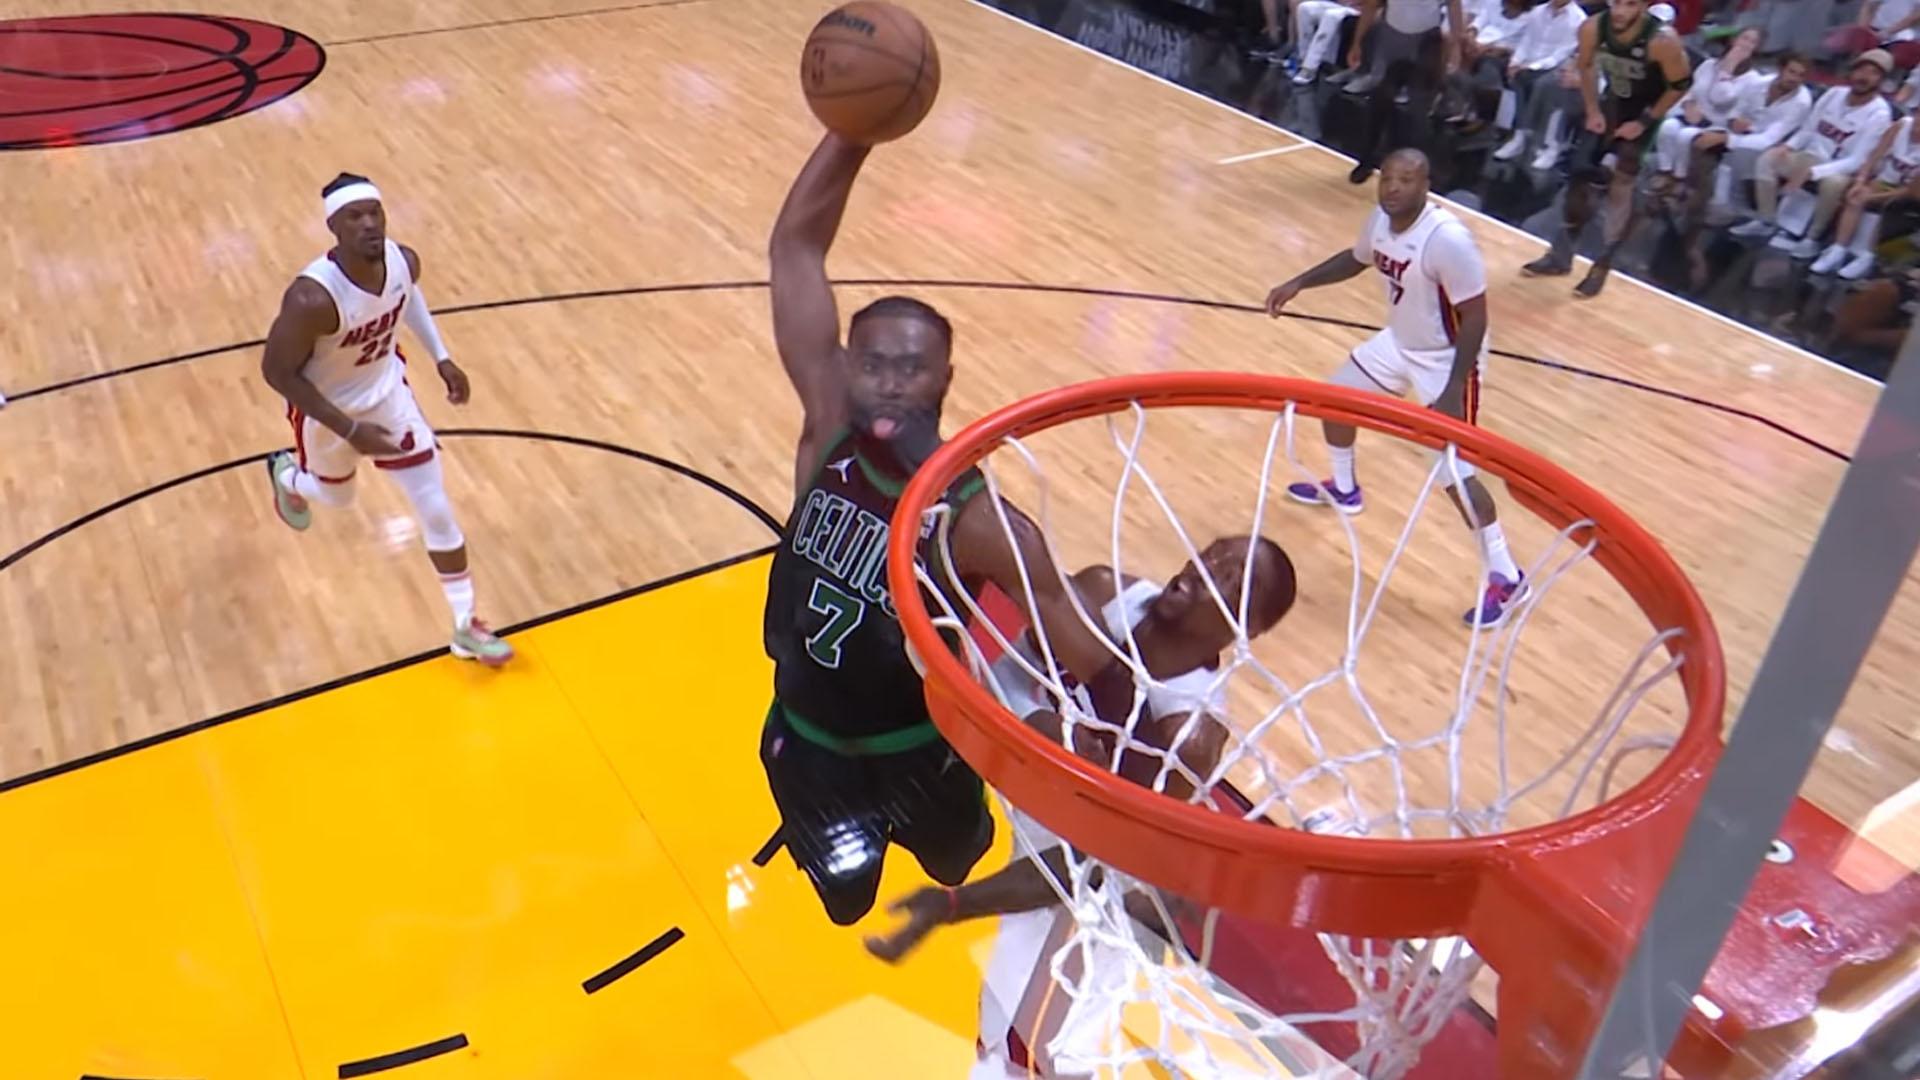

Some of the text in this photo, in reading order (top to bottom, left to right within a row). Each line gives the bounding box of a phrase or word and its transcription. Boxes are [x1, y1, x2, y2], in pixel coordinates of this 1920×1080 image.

[1373, 249, 1412, 281] HEAT
[339, 294, 406, 348] HEAT
[354, 333, 393, 366] 22
[805, 578, 865, 669] 7
